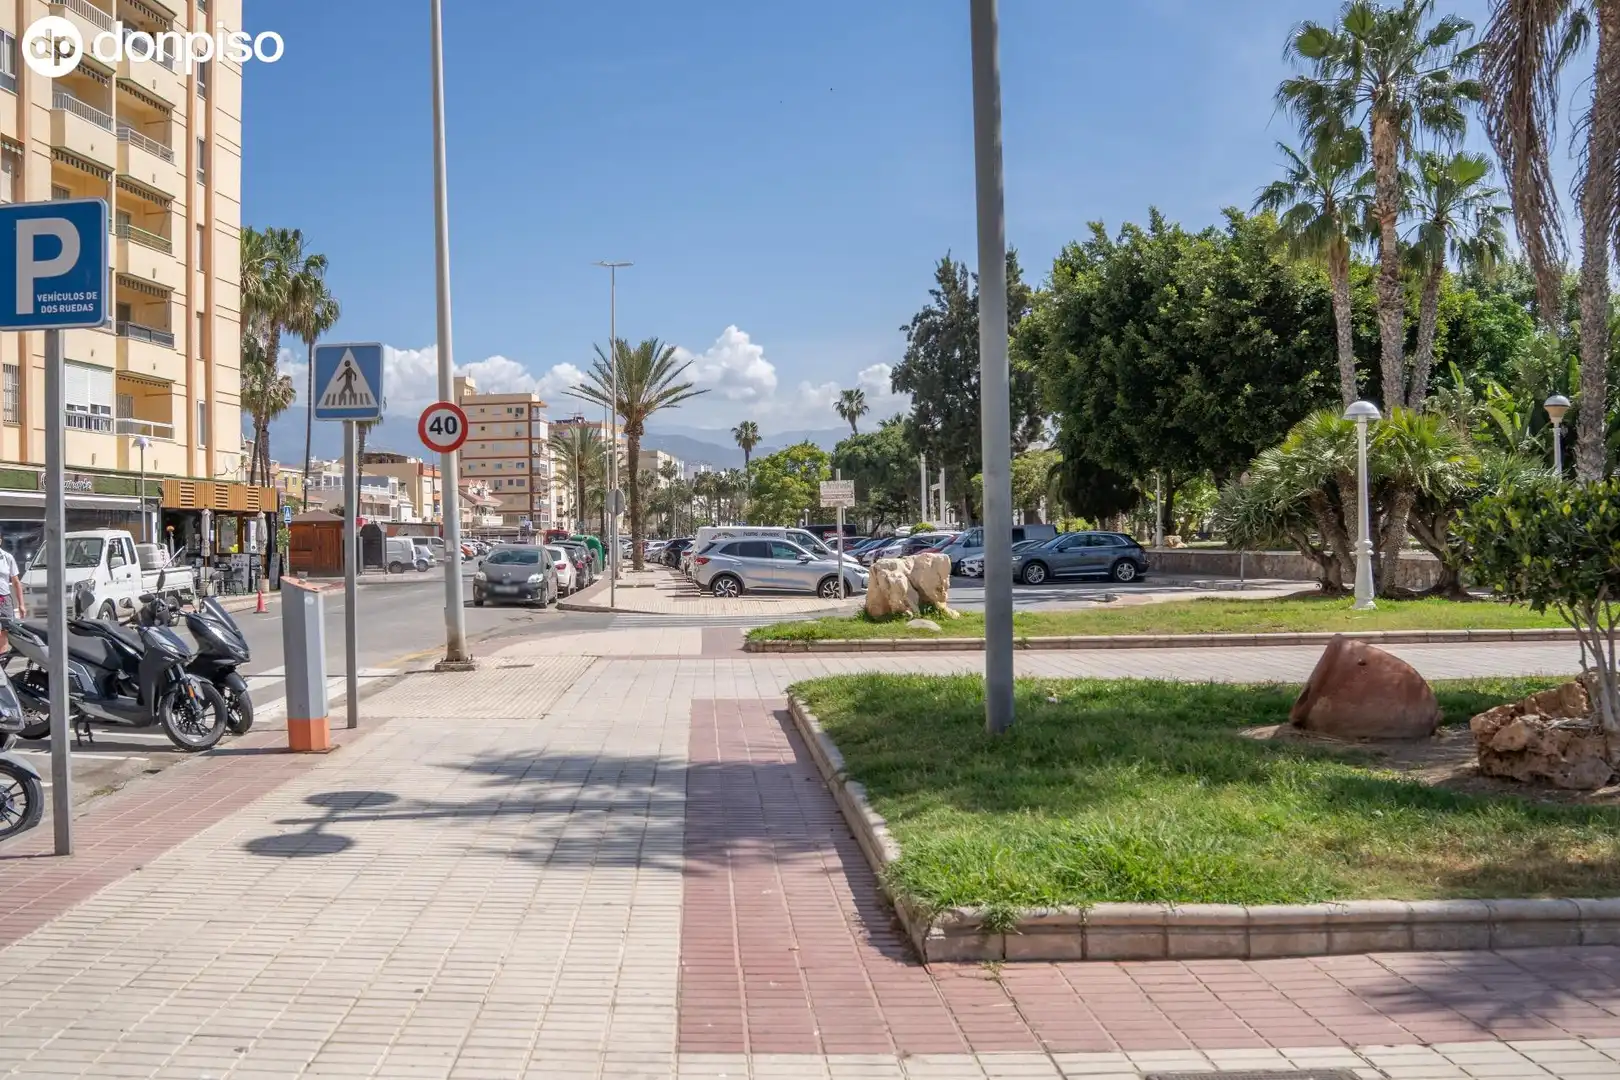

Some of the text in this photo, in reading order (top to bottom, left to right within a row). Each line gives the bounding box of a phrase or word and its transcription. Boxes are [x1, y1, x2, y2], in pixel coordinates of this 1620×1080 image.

[16, 217, 80, 315] P
[86, 291, 98, 300] DE
[41, 303, 94, 314] DOS RUEDAS
[429, 416, 457, 435] 40
